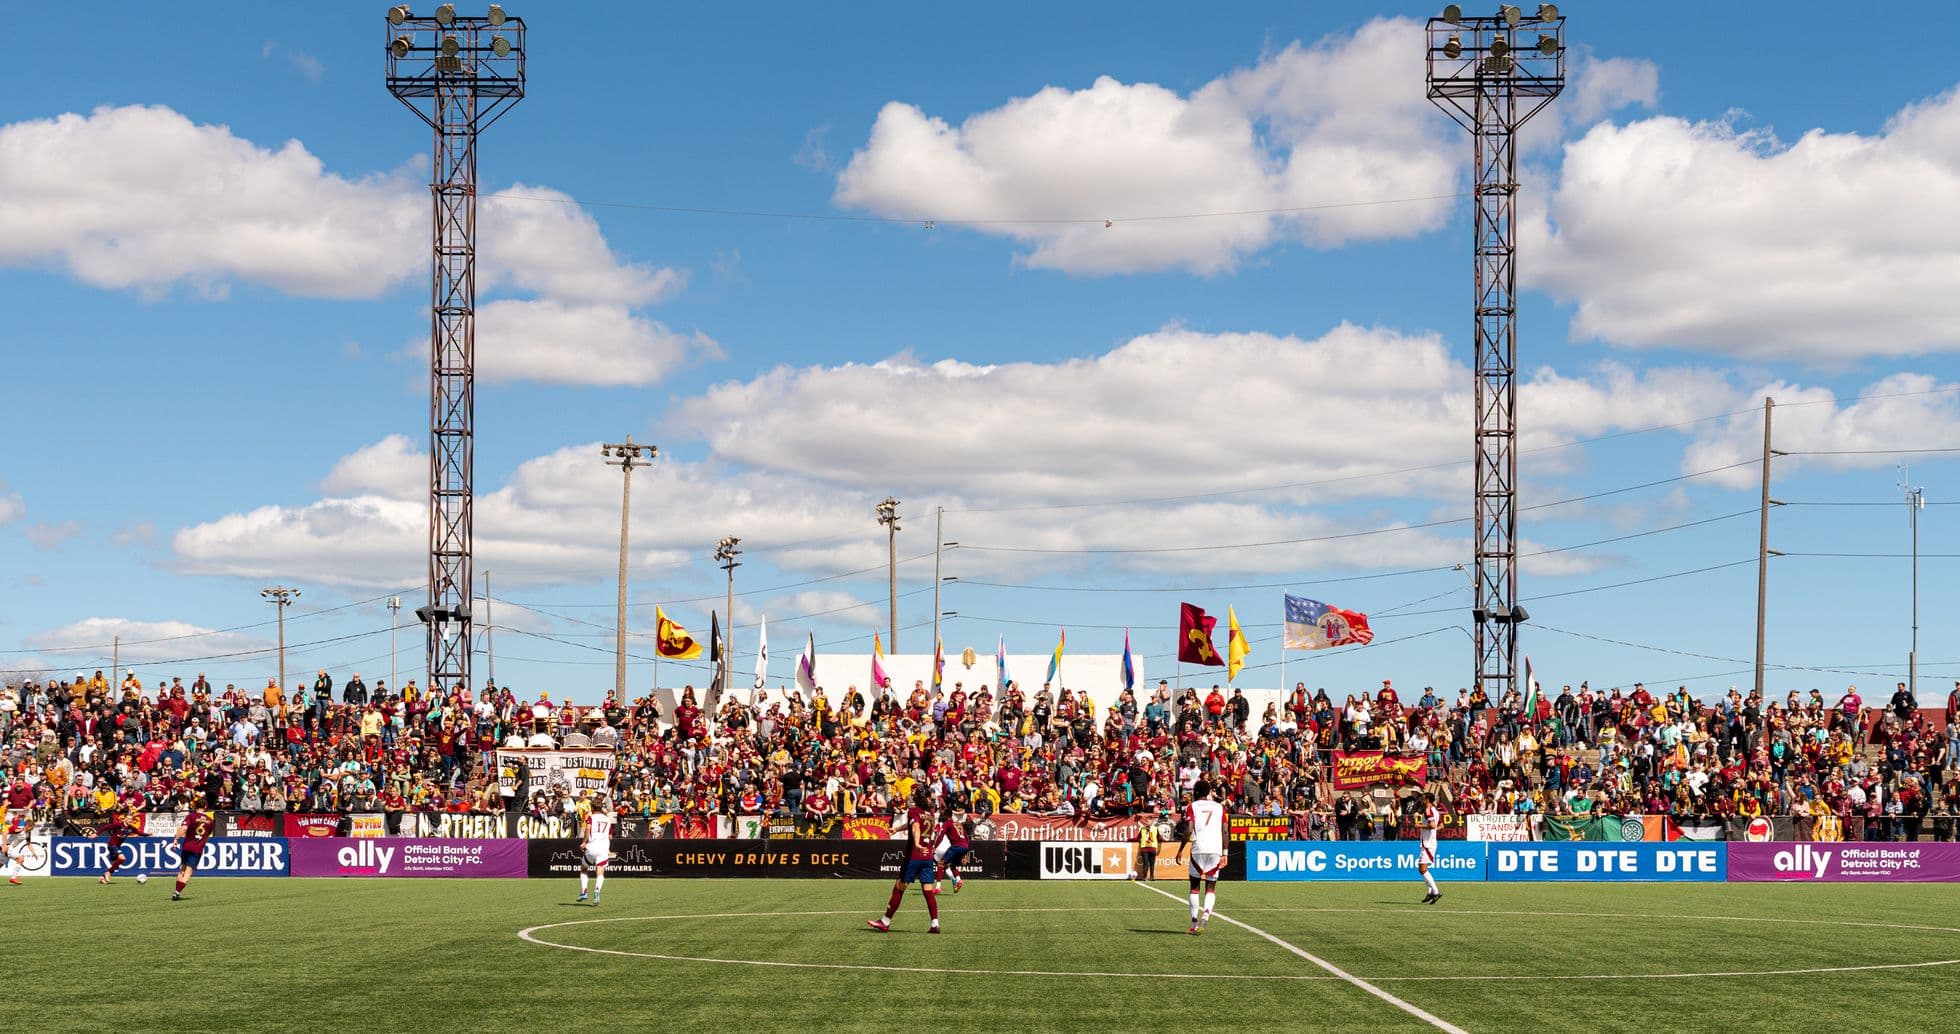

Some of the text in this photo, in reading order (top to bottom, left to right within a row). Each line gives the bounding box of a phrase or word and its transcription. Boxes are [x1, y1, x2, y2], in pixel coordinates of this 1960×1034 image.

[1338, 755, 1383, 768] DETROIT
[576, 777, 605, 788] GROUP
[844, 818, 890, 831] REFUGEES
[1202, 810, 1212, 826] 7
[1231, 818, 1289, 826] COALITION
[196, 822, 206, 835] 6
[419, 812, 508, 838] NRTHERN
[596, 822, 608, 833] 17
[920, 820, 931, 837] 2
[998, 820, 1083, 841] Northern
[1231, 833, 1288, 841] DETROIT
[56, 840, 284, 870] STROH'S BEER
[404, 845, 482, 854] Official Bank of
[1841, 850, 1920, 858] Official Bank of
[338, 840, 395, 874] ally
[404, 855, 440, 864] Detroit
[442, 855, 464, 866] City
[675, 853, 849, 865] CHEVY DRIVES DCFC
[1045, 847, 1102, 874] USL
[1257, 851, 1326, 872] DMC
[1335, 854, 1392, 869] Sports
[1498, 850, 1716, 872] DTE DTE DTE
[1774, 844, 1832, 878] ally
[1841, 860, 1878, 868] Detroit
[1880, 860, 1901, 870] City
